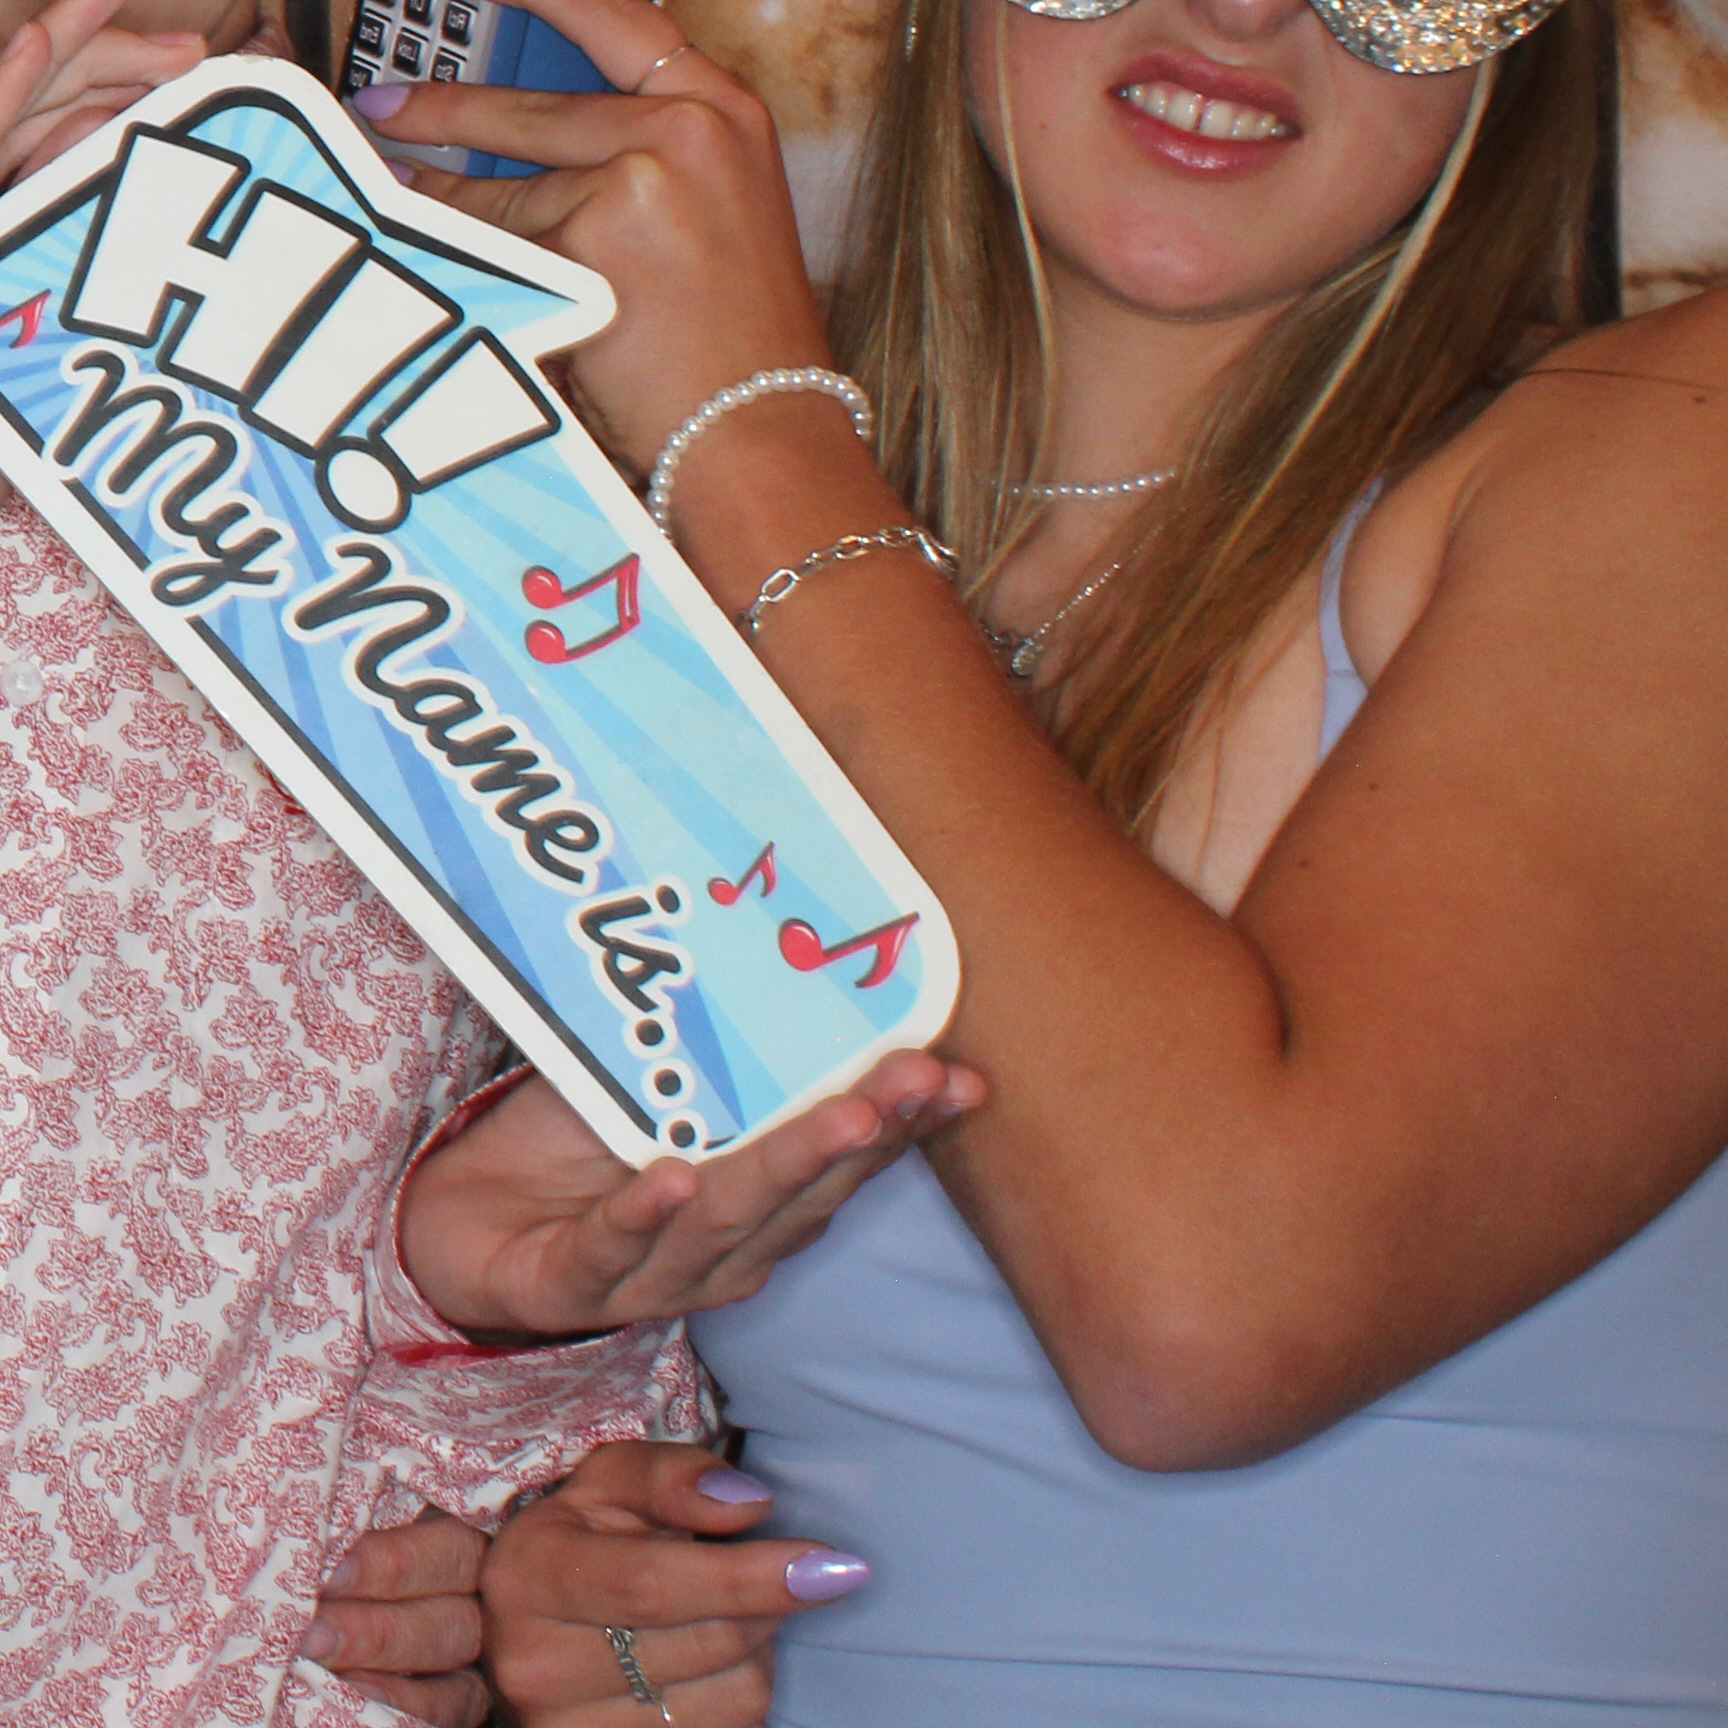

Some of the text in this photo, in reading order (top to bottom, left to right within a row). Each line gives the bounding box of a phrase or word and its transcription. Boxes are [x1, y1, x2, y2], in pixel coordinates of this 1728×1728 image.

[59, 121, 562, 534] HI!
[53, 349, 283, 607] My
[295, 543, 599, 884] Name
